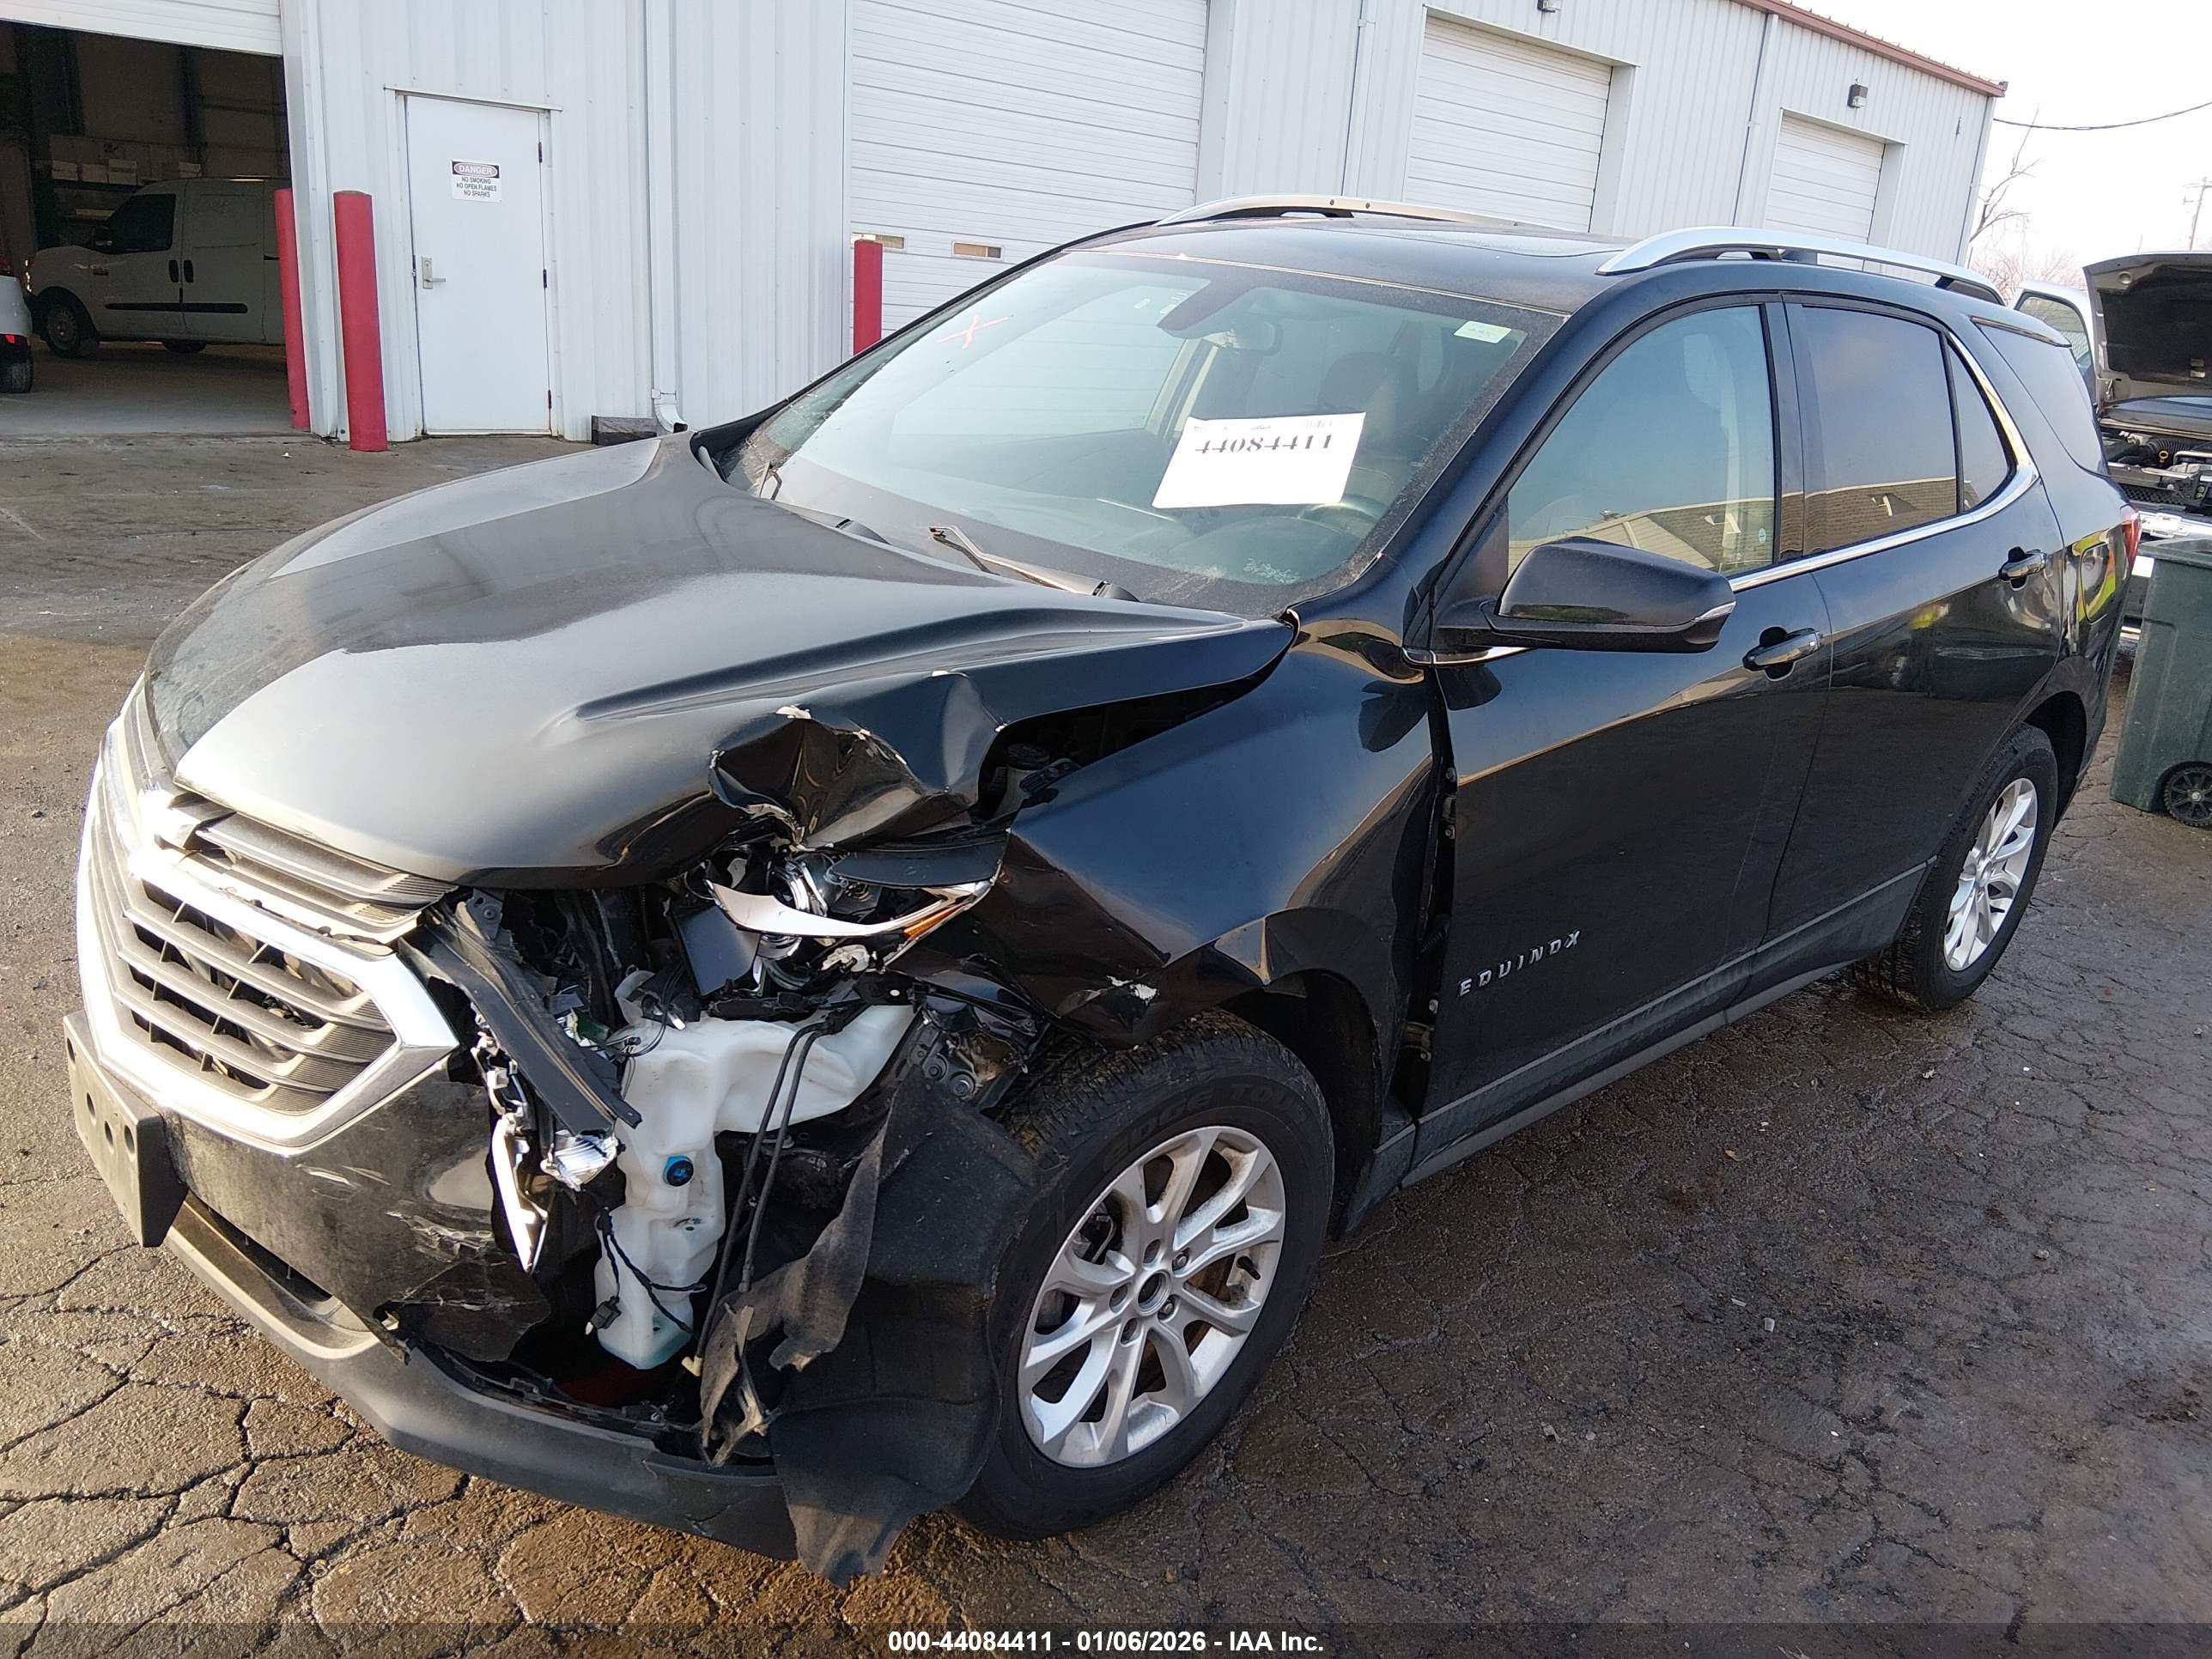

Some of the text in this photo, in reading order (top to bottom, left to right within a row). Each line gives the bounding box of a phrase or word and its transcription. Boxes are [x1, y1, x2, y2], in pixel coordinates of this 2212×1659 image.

[459, 165, 492, 174] DANGER
[1194, 434, 1332, 453] 44084411
[1459, 930, 1580, 997] EQUINOX
